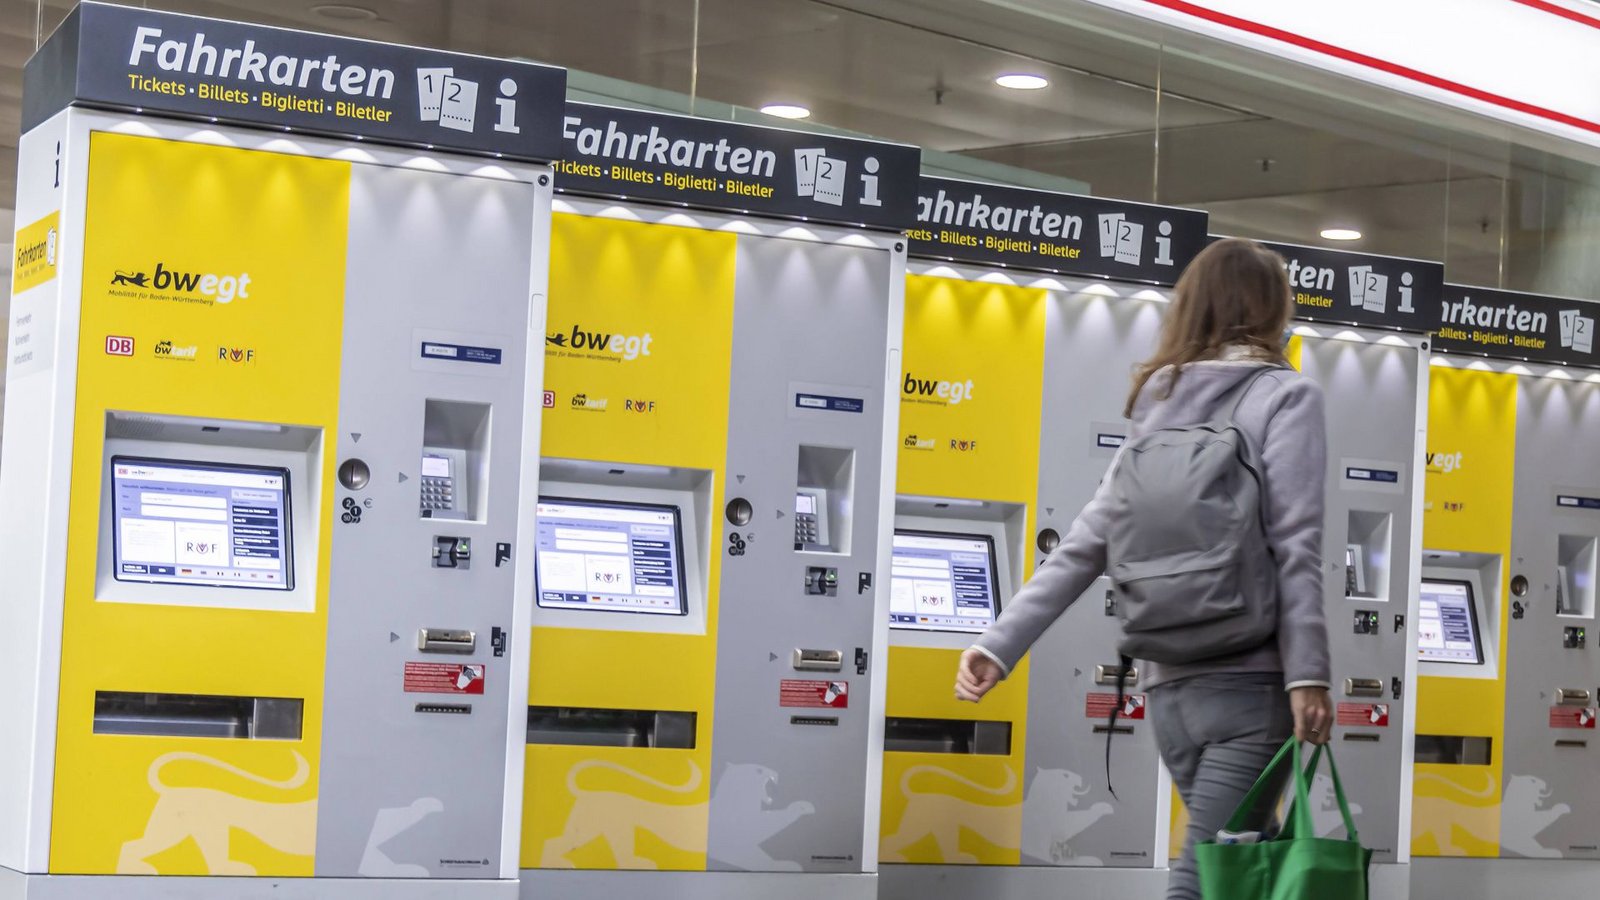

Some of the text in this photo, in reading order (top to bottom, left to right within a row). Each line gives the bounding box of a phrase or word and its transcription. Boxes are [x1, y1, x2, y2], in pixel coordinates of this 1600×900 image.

[129, 26, 395, 99] Fahrkarten
[128, 74, 392, 122] Tickets Billets Biglietti Biletler
[563, 115, 776, 178] Fahrkarten
[611, 165, 654, 184] Billets
[663, 173, 717, 191] Biglietti
[726, 180, 774, 198] Biletler
[917, 190, 1083, 240] ahrkarten
[940, 231, 977, 247] Billets
[985, 237, 1031, 253] Biglietti
[1039, 243, 1080, 259] Biletler
[153, 263, 251, 304] bwegt
[1287, 259, 1335, 291] ten
[108, 289, 137, 299] Mobilität
[1296, 293, 1333, 308] Biletler
[1441, 296, 1548, 334] rkarten
[109, 338, 131, 353] DB
[571, 325, 652, 360] bwegt
[1472, 330, 1508, 346] Biglietti
[1513, 335, 1546, 349] Biletler
[543, 393, 552, 405] B
[903, 373, 973, 404] bwegt
